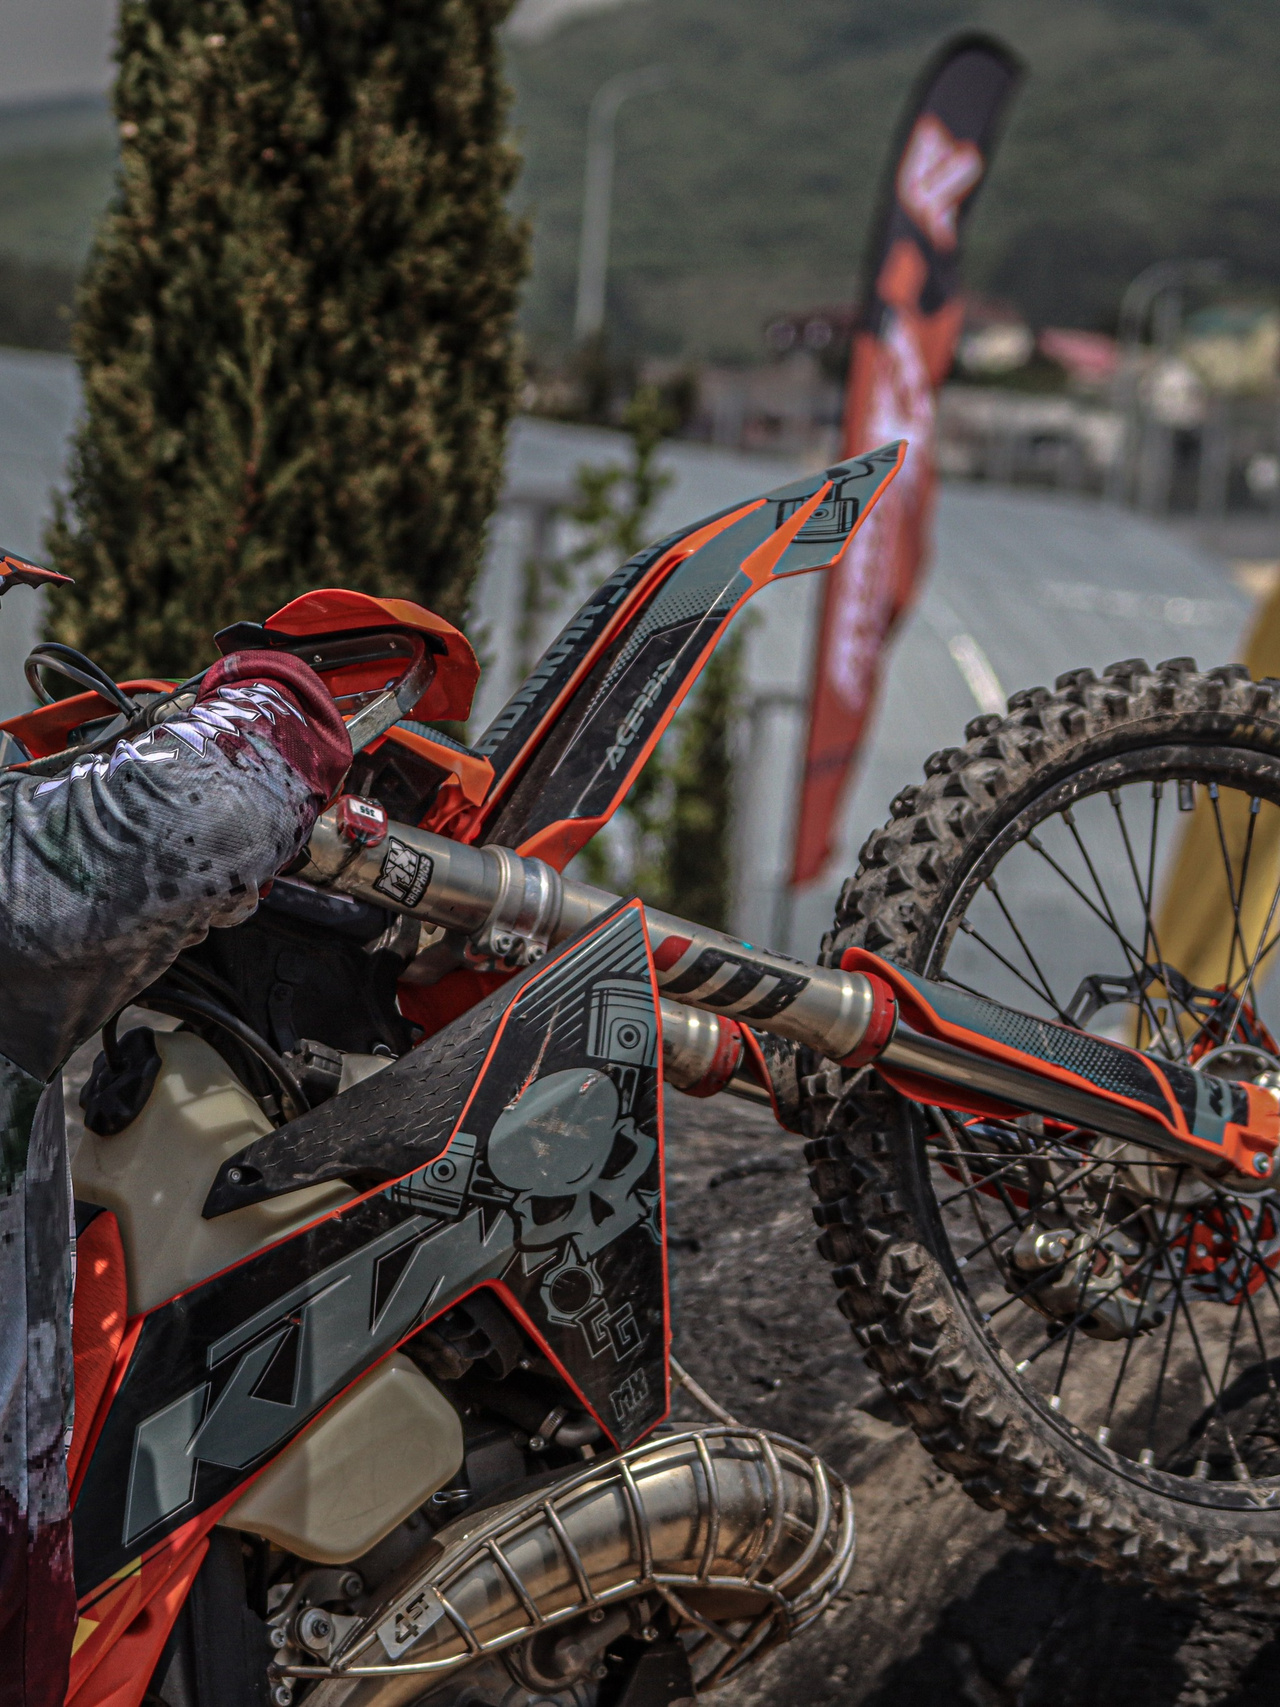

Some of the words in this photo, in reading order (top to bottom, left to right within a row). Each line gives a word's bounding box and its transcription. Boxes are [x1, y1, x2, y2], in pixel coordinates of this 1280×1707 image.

[359, 805, 376, 817] 355
[377, 838, 419, 901] MX
[405, 855, 431, 905] GRAPHICS
[122, 1205, 558, 1548] KTM
